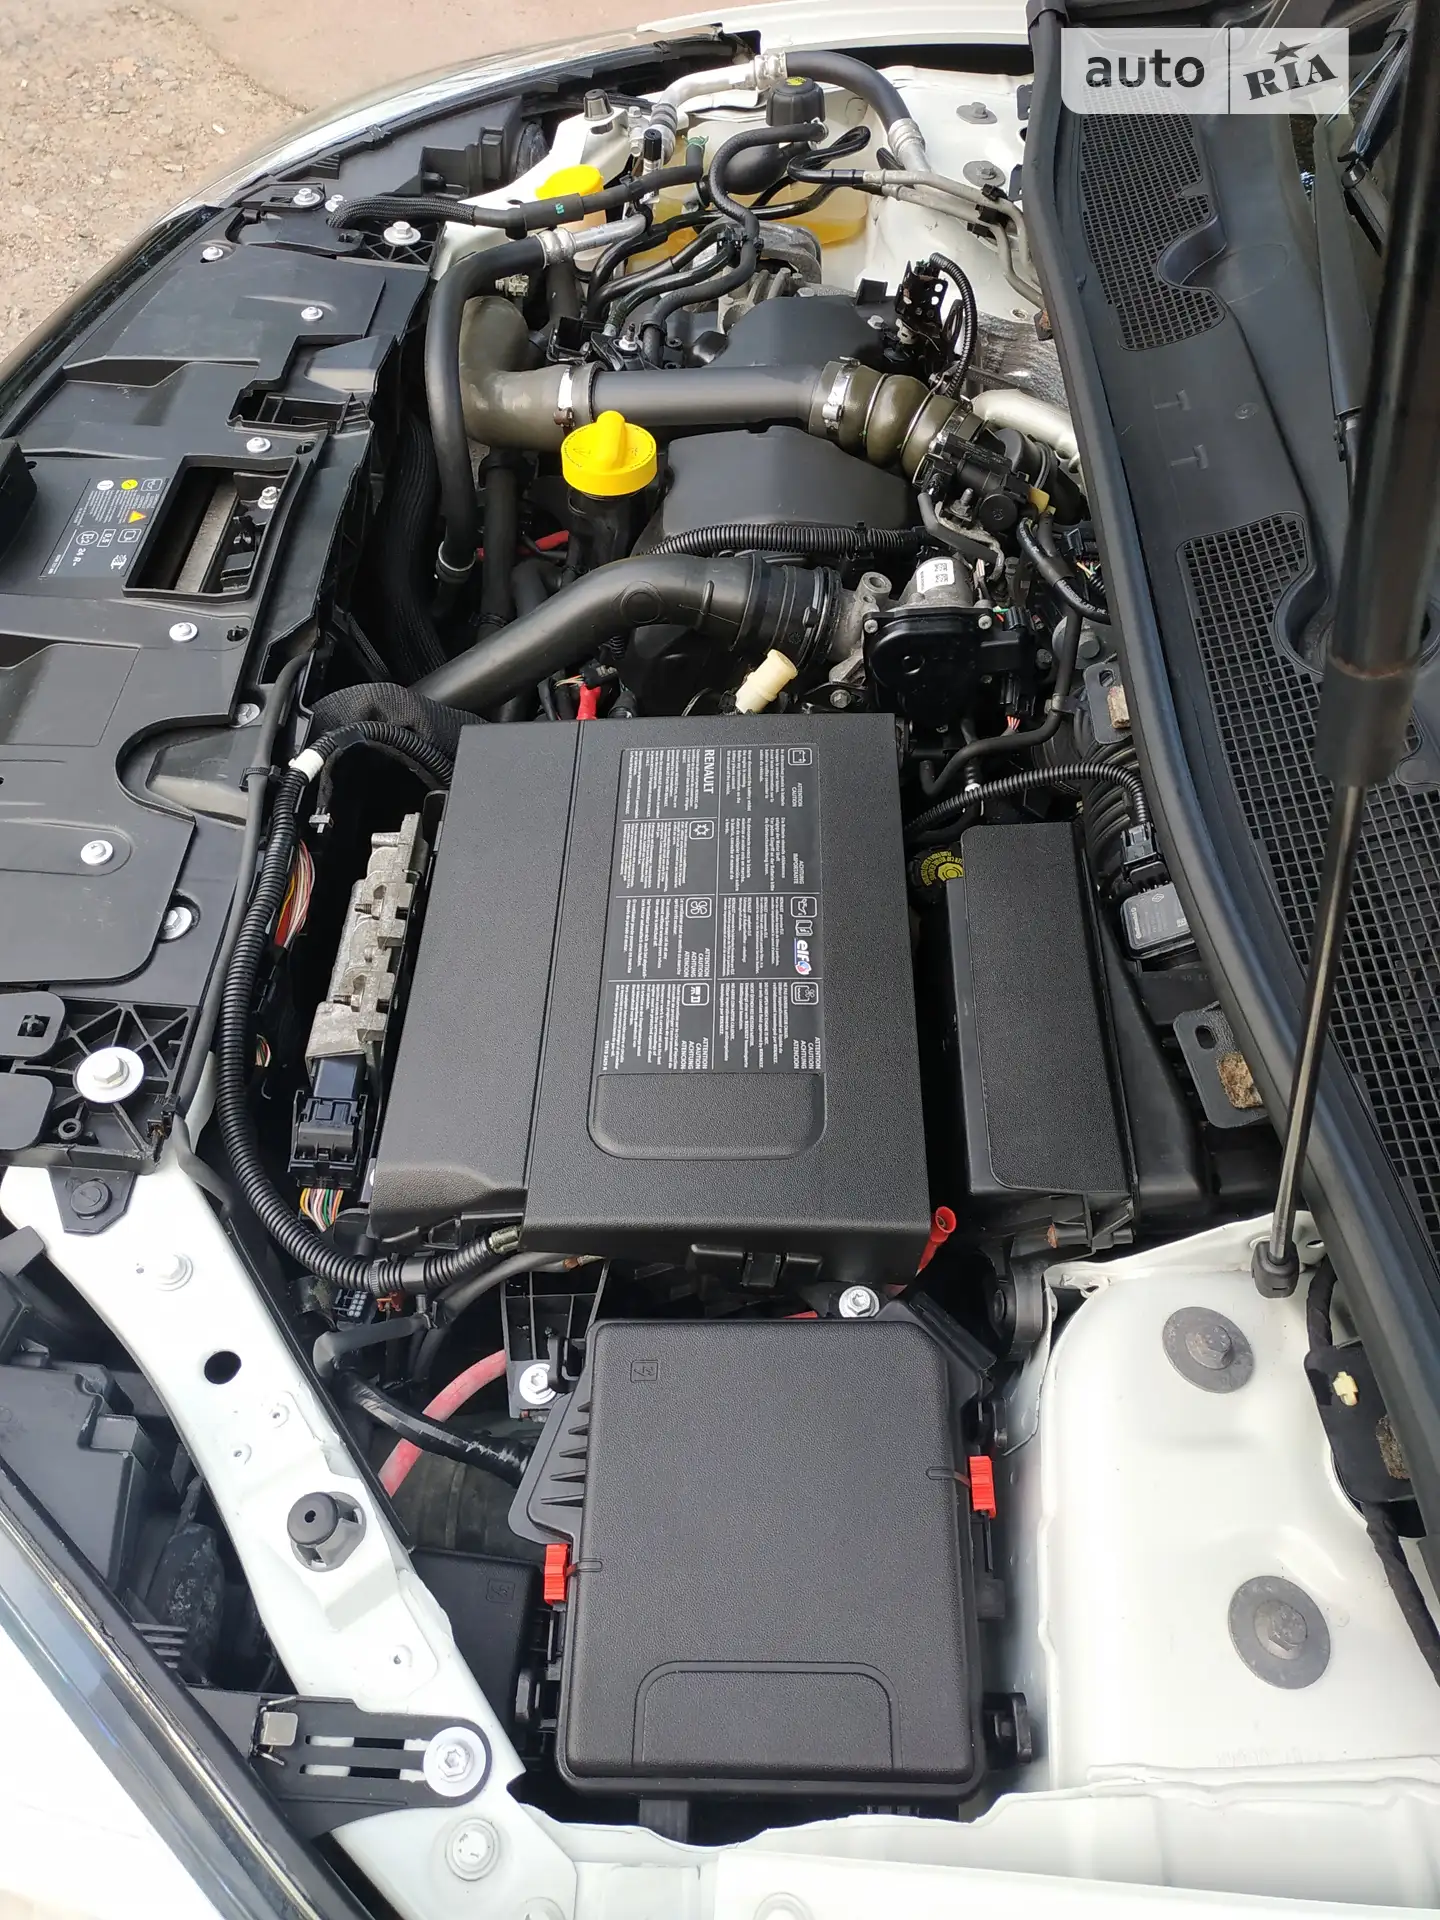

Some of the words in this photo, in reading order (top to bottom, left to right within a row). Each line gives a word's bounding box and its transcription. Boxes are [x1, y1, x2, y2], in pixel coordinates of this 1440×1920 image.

[76, 548, 87, 556] 24
[703, 749, 715, 794] RENAULT
[797, 940, 810, 962] elf
